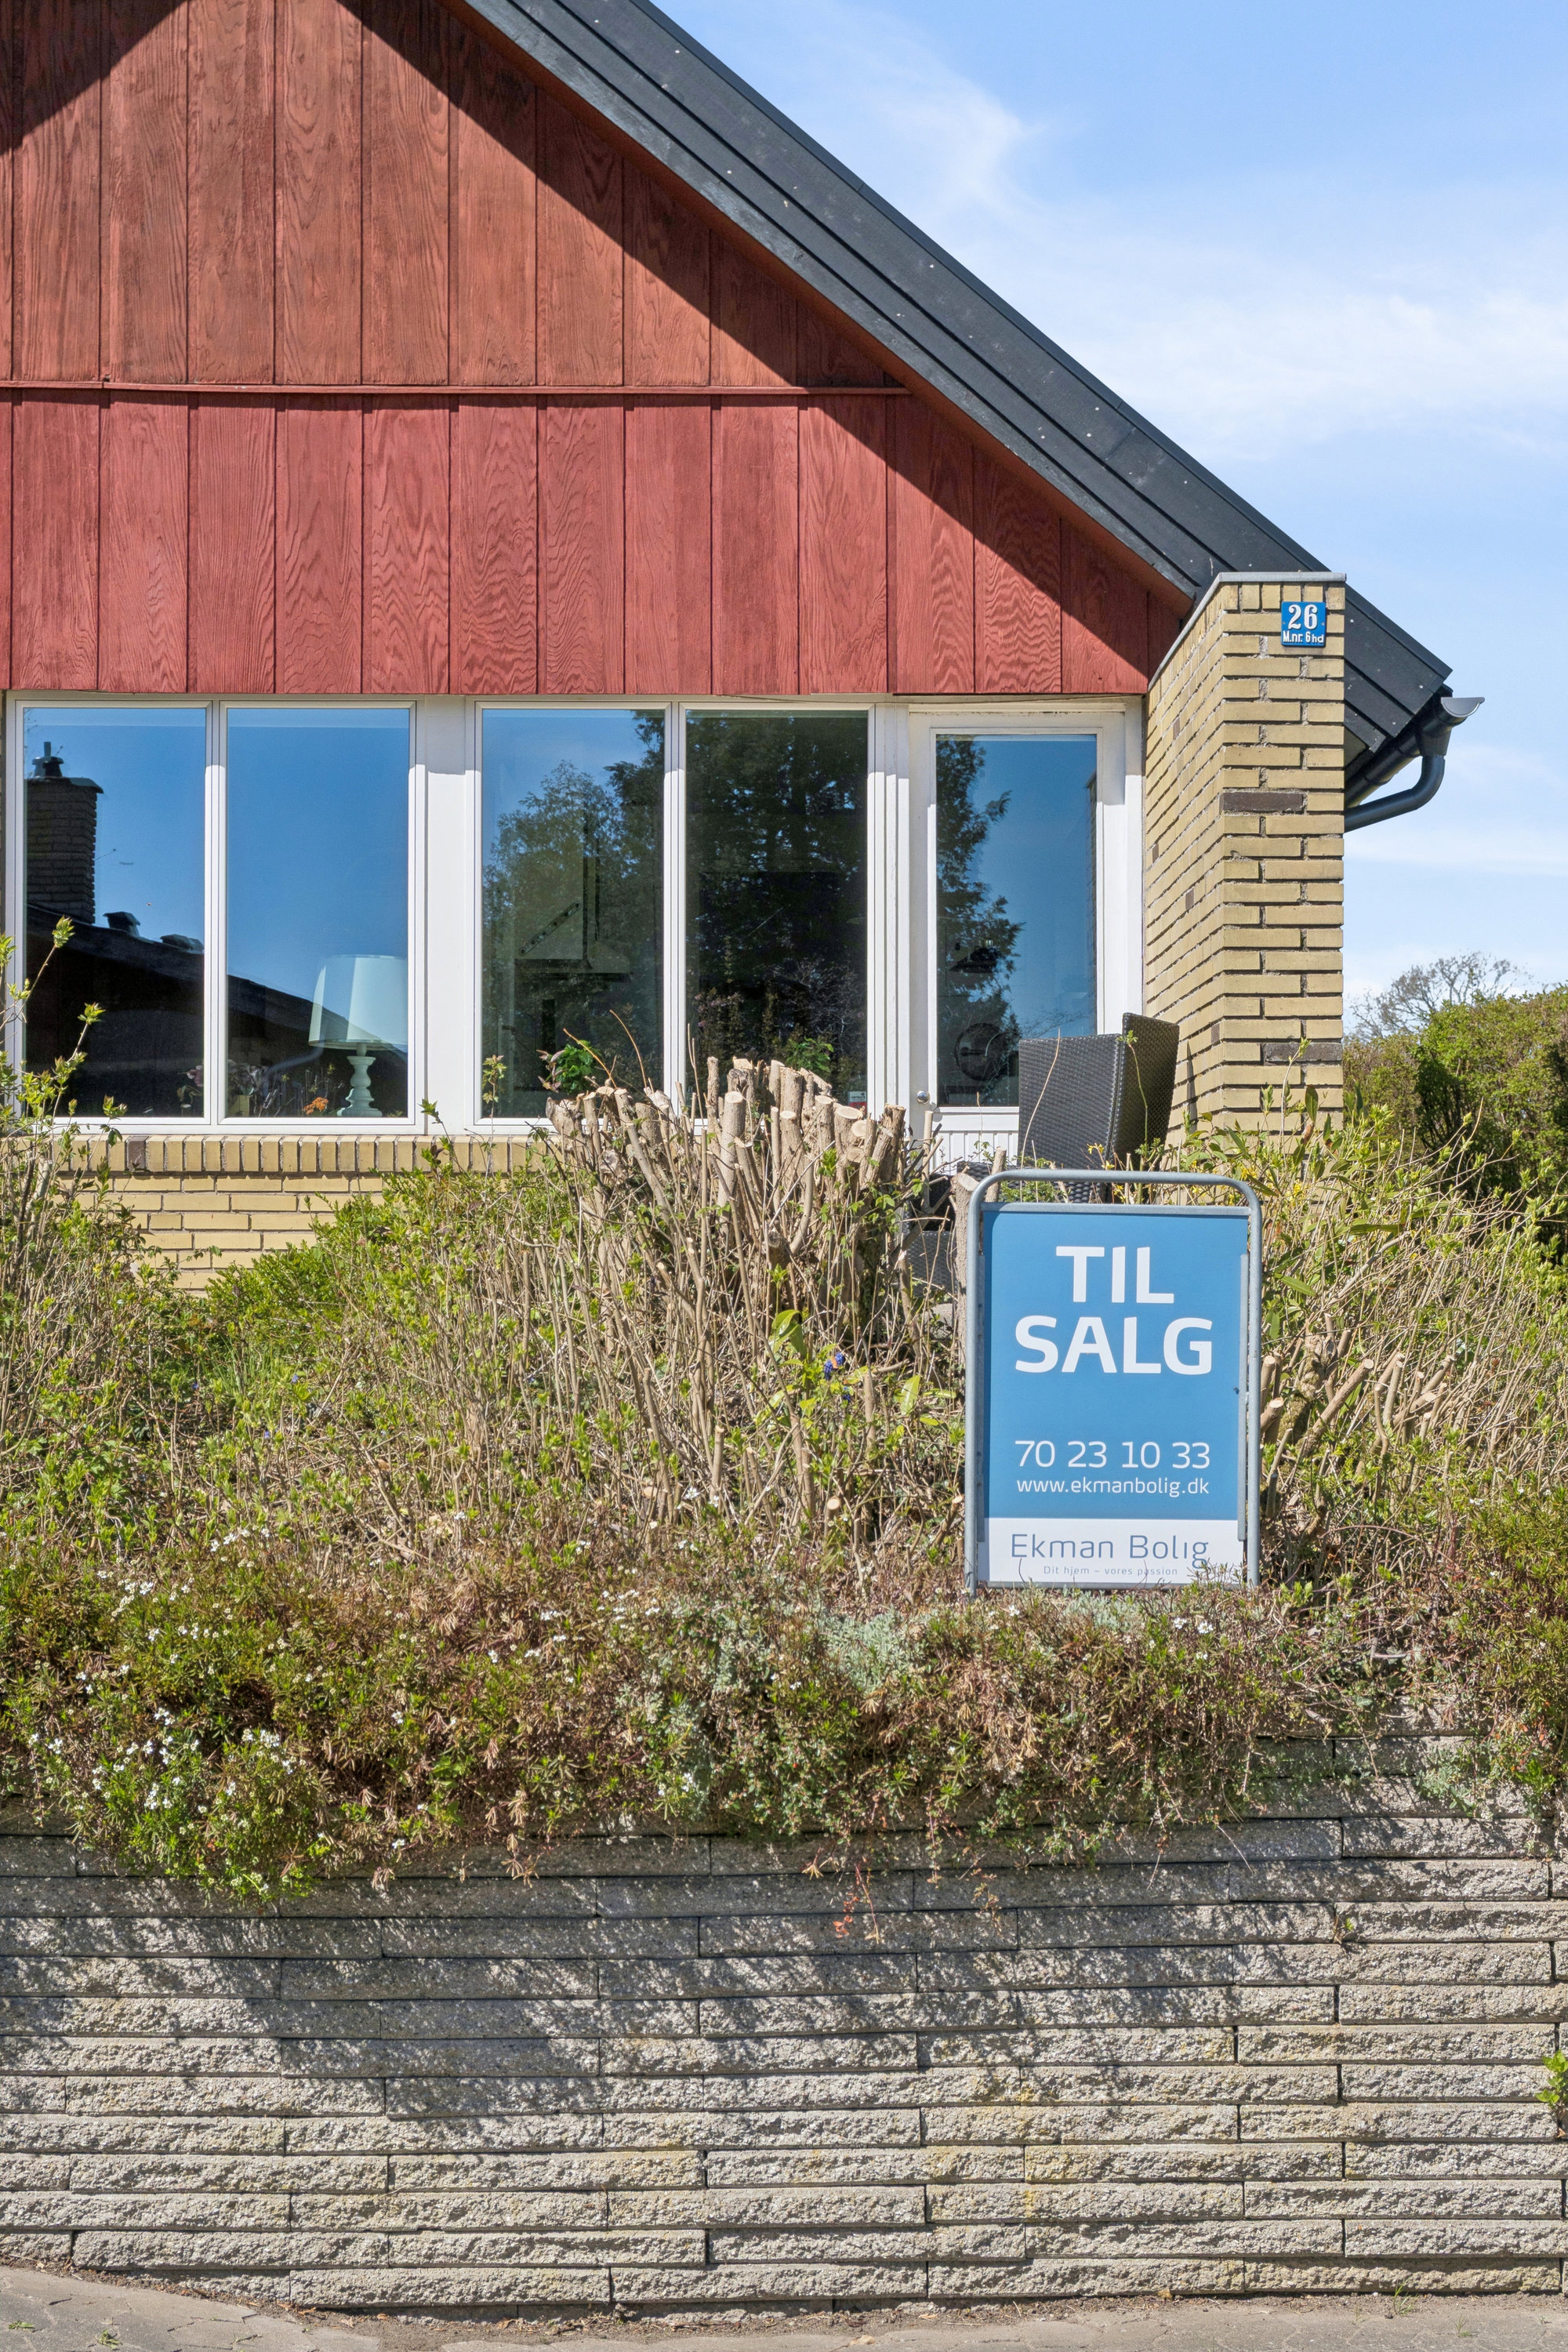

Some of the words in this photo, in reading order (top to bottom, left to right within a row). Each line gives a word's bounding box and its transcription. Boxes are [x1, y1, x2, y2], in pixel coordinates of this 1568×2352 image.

[1287, 604, 1318, 630] 26
[1056, 1246, 1174, 1303] TIL
[1015, 1316, 1212, 1375] SALG
[1015, 1440, 1055, 1468] 70
[1068, 1441, 1106, 1468] 23
[1122, 1441, 1160, 1469] 10
[1172, 1443, 1210, 1468] 33
[1017, 1477, 1209, 1497] www.ekmanbolig.dk
[1011, 1533, 1114, 1559] Ekman
[1130, 1535, 1208, 1570] Bolig
[1044, 1566, 1059, 1575] Dit
[1063, 1566, 1090, 1577] hjem
[1104, 1567, 1133, 1576] vores
[1137, 1566, 1178, 1577] passion
